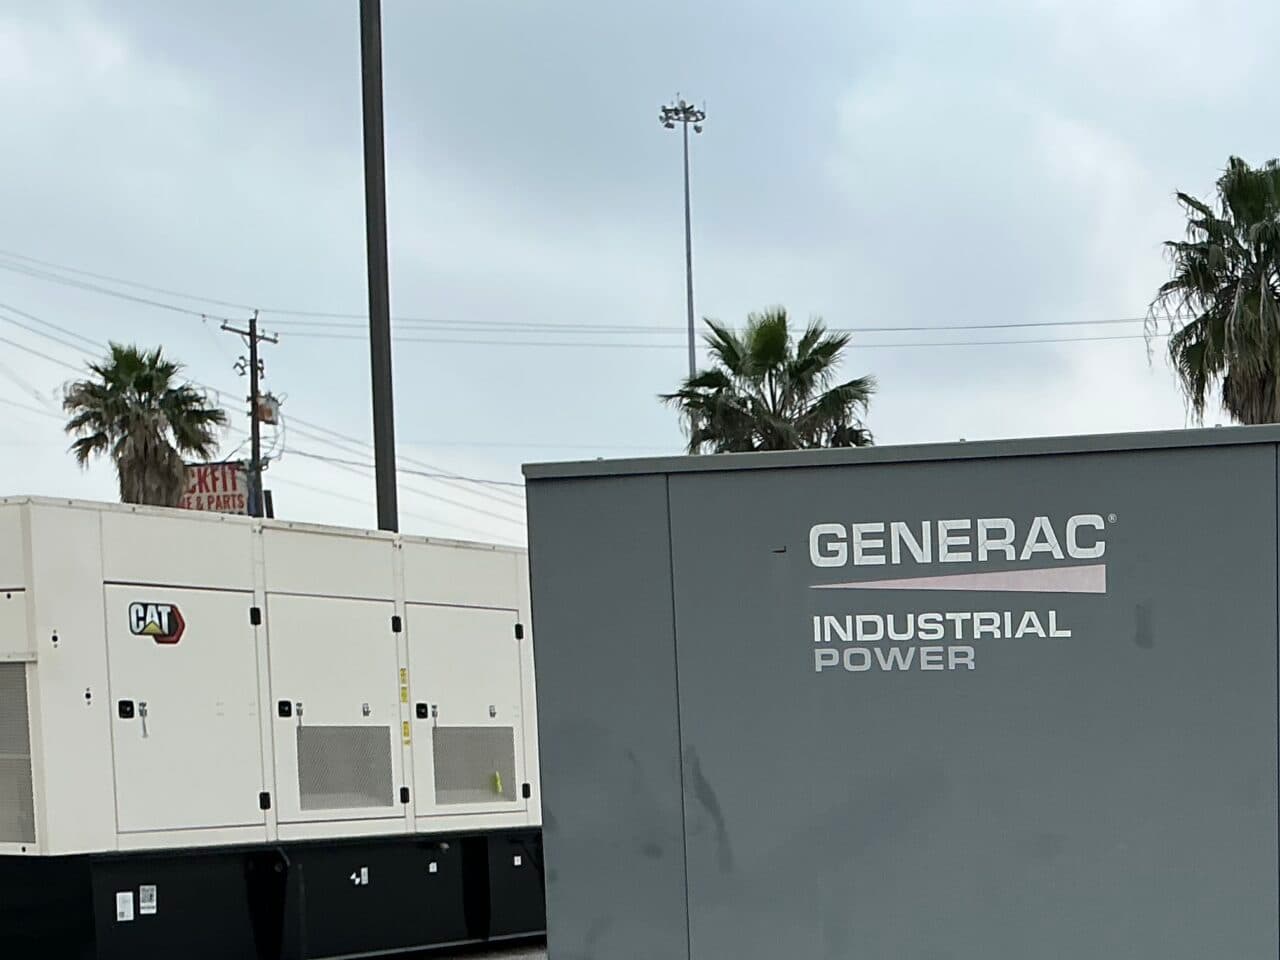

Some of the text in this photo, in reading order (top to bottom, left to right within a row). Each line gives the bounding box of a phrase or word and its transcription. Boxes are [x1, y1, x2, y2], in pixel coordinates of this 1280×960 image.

[208, 493, 244, 510] PARTS
[130, 603, 171, 635] CAT
[813, 610, 1072, 642] INDUSTRIAL
[814, 645, 975, 672] POWER
